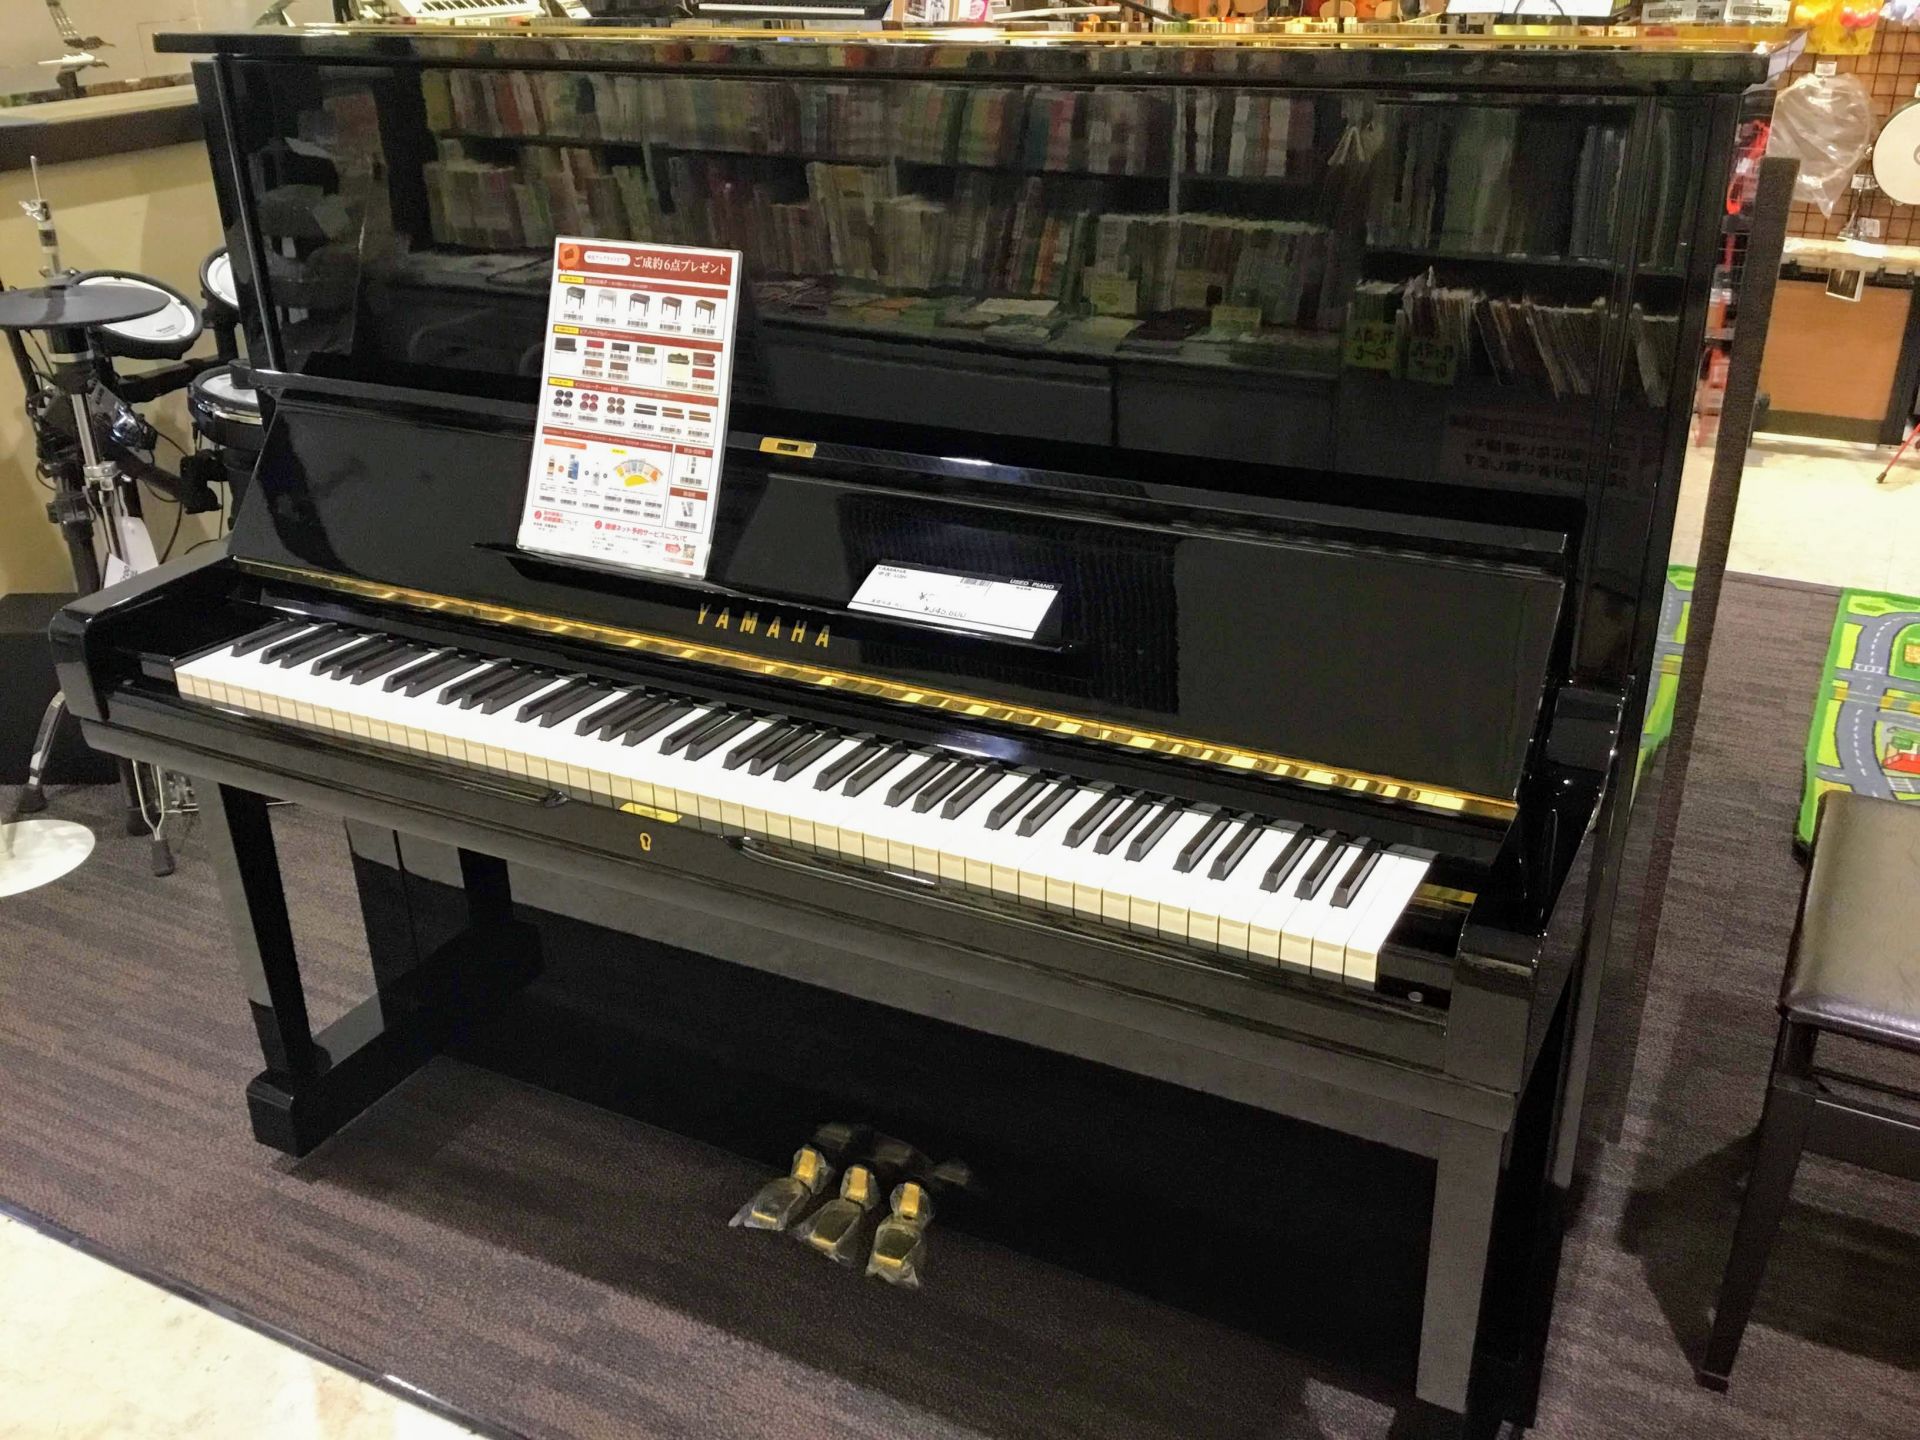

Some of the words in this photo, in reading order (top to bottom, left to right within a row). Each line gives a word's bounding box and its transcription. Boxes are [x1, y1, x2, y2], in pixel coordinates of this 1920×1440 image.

[633, 256, 727, 276] ご成約6点プレゼント
[1032, 582, 1054, 590] PIANO
[697, 602, 831, 648] YAMAHA
